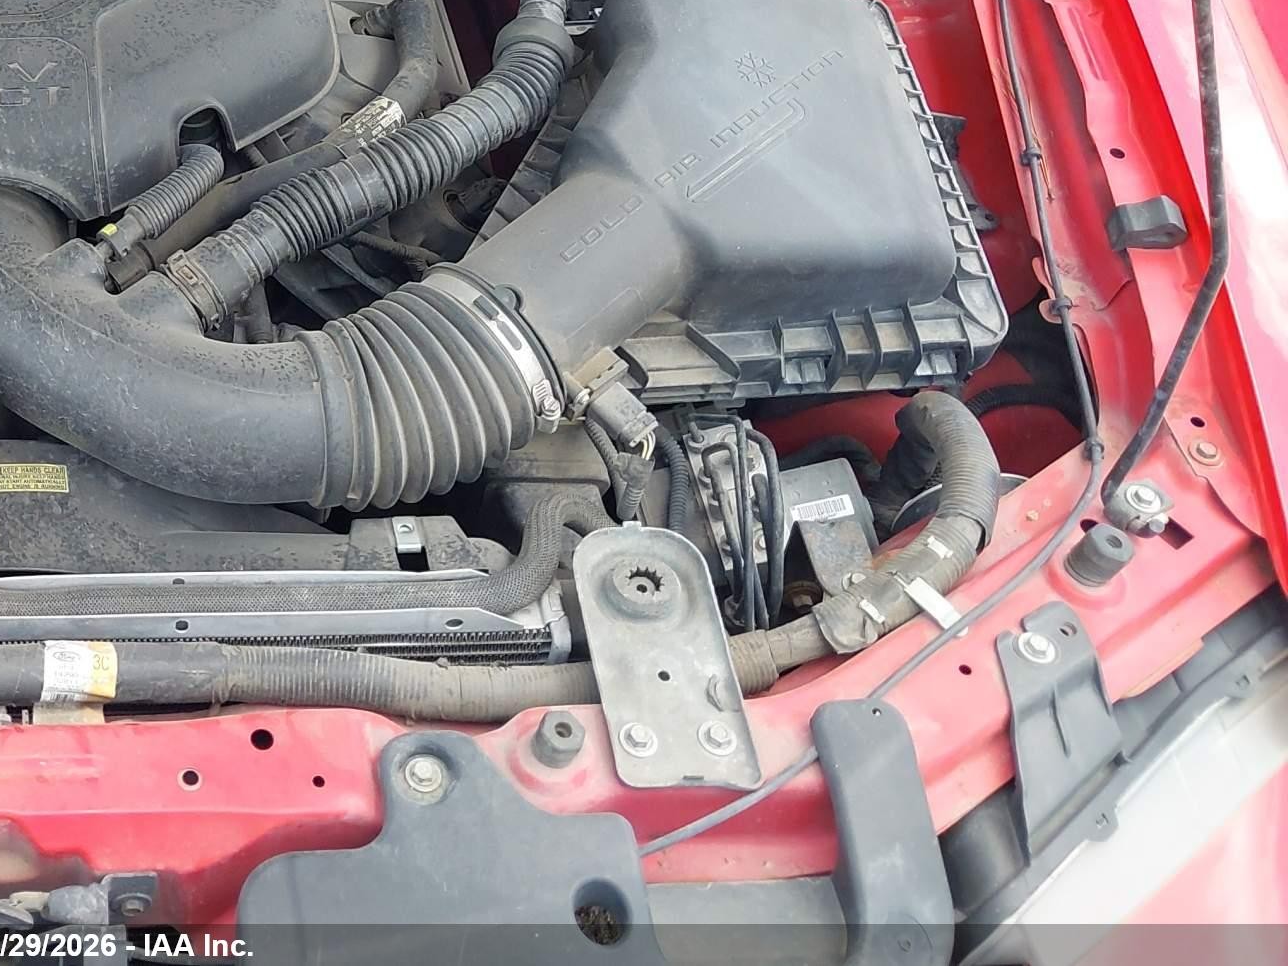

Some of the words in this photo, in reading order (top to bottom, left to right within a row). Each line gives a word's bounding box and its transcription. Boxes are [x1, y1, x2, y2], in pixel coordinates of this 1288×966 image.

[560, 194, 644, 264] COLD
[654, 153, 704, 188] AIR
[2, 466, 19, 475] KEEP
[21, 466, 42, 474] HANDS
[43, 466, 65, 474] CLEAR
[92, 653, 111, 671] 3C
